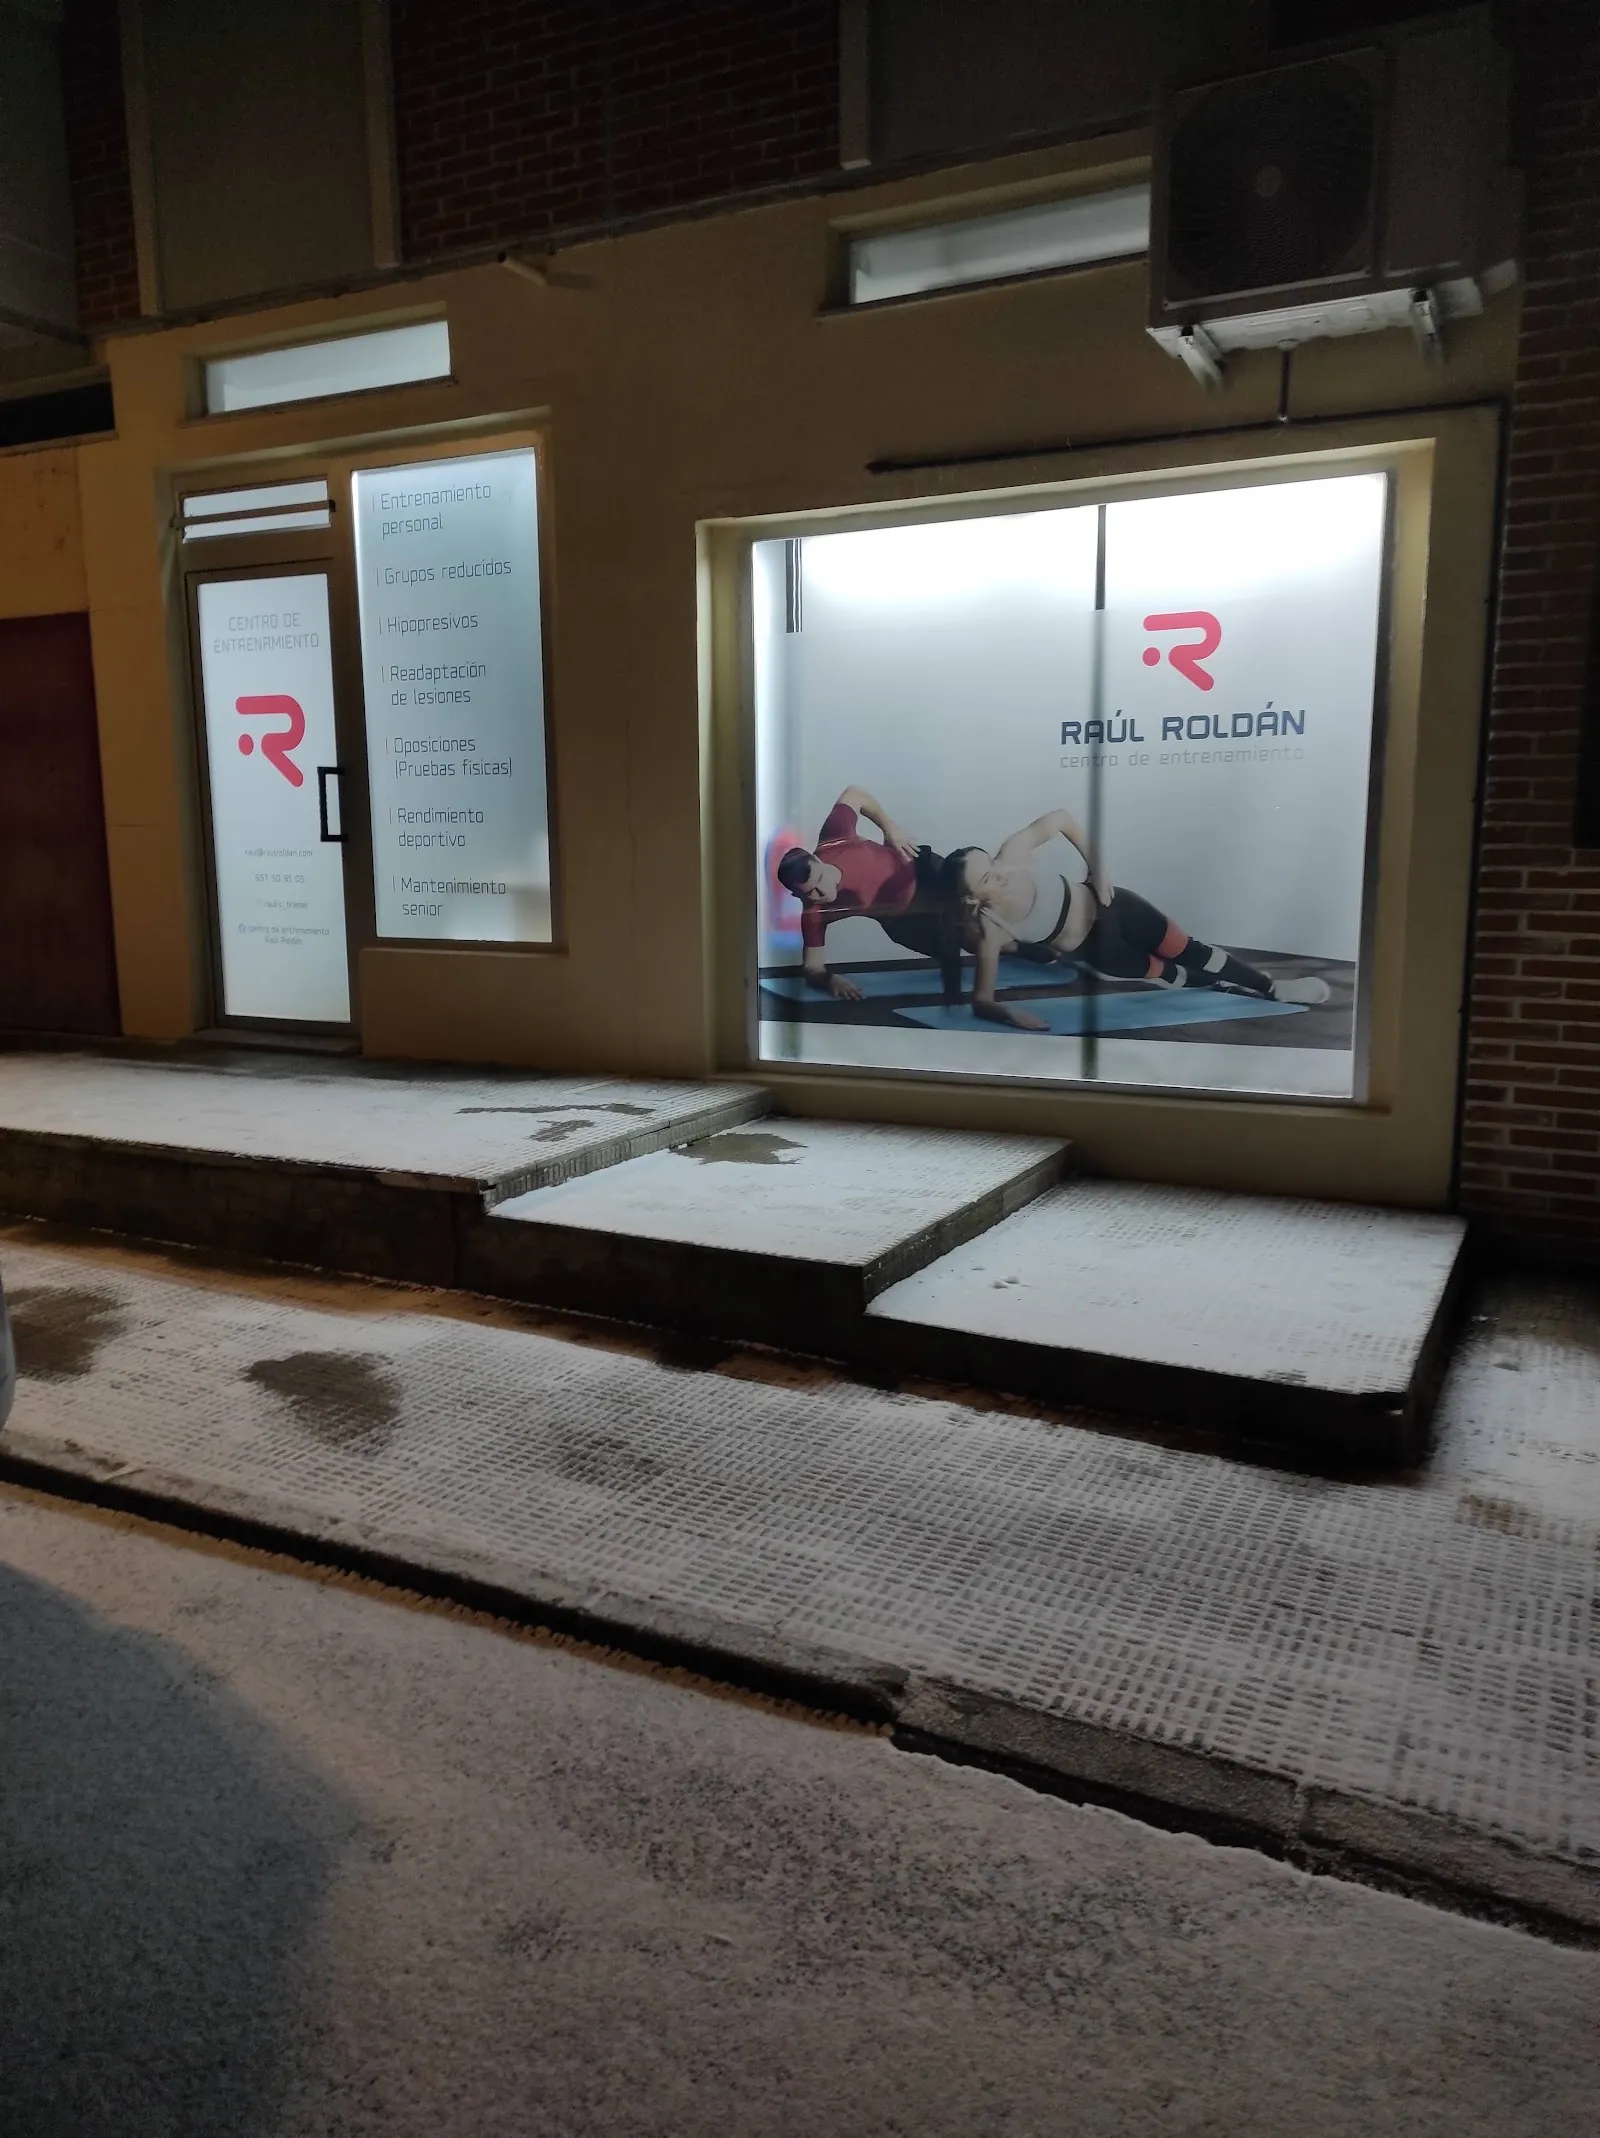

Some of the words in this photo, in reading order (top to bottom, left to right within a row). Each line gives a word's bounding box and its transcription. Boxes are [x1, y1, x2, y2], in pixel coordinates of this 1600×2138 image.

[381, 483, 491, 510] Entrenamiento
[382, 512, 443, 540] personal
[385, 566, 435, 586] Grupos
[441, 558, 512, 580] reducidos
[228, 613, 278, 632] CENTRO
[284, 612, 301, 628] DE
[388, 613, 478, 637] Hipopresivos
[213, 633, 319, 654] ENTRENAMIENTO
[390, 661, 486, 685] Readaptación
[391, 689, 408, 706] de
[413, 688, 471, 705] lesiones
[1060, 709, 1144, 745] RAÚL
[1161, 700, 1305, 742] ROLDÁN
[394, 736, 476, 757] Oposiciones
[1060, 752, 1118, 768] centro
[1128, 750, 1149, 766] de
[1160, 744, 1305, 766] entrenamiento
[395, 759, 456, 779] (Pruebas
[462, 757, 512, 777] físicas)
[397, 807, 484, 825] Rendimiento
[398, 831, 466, 850] deportivo
[401, 876, 506, 895] Mantenimiento
[402, 900, 443, 917] senior
